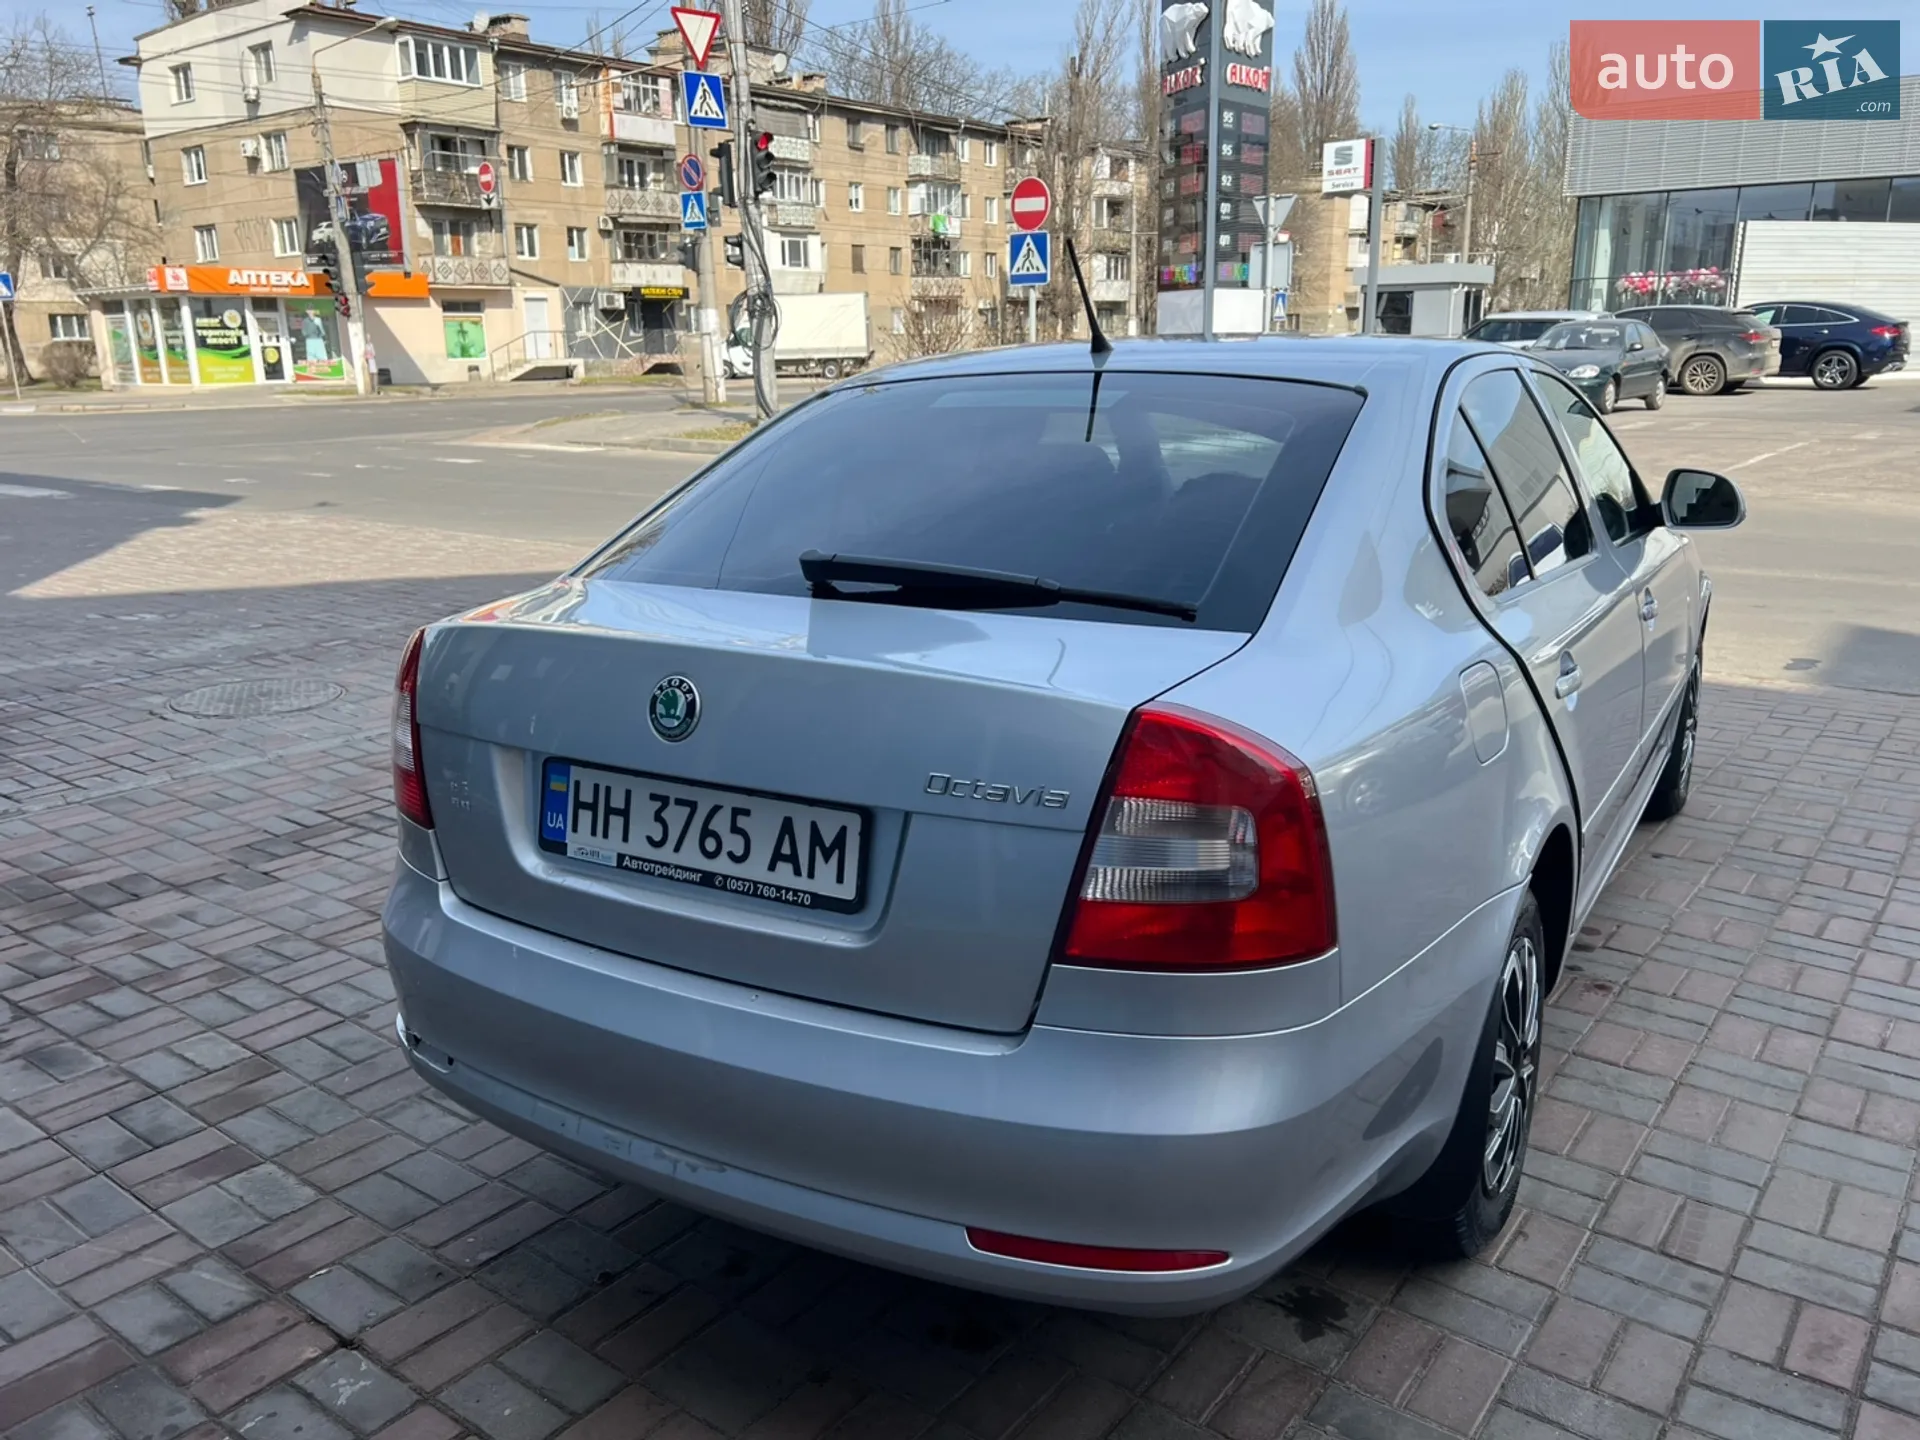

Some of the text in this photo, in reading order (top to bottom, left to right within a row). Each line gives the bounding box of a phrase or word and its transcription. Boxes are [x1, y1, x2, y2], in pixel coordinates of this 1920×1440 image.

[1222, 111, 1234, 123] 95
[1221, 144, 1233, 155] 95
[1221, 174, 1232, 186] 92
[1327, 167, 1359, 176] SEAT
[228, 269, 310, 287] АПТЕКА
[925, 771, 1070, 810] Octavia
[547, 812, 565, 831] UA
[571, 780, 848, 884] HH 3765 AM
[623, 856, 812, 906] Автотрейдинг (057) 760-14-70
